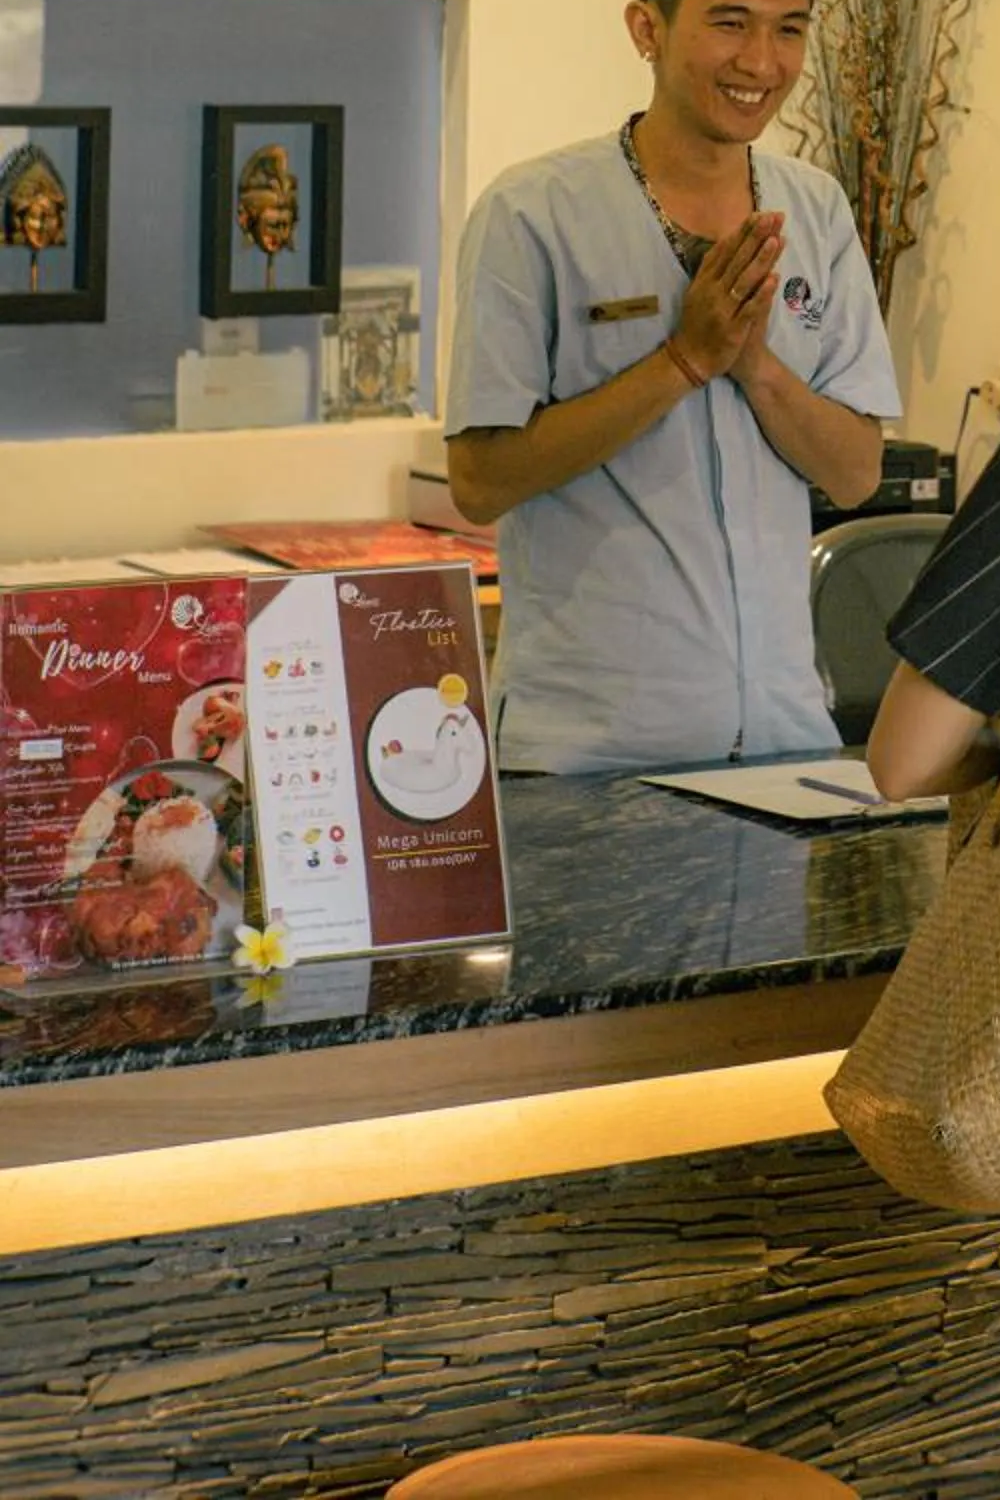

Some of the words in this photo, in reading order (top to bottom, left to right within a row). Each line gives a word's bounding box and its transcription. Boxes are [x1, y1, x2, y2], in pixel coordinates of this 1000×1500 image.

[428, 631, 459, 647] List
[40, 638, 145, 681] Dinner
[137, 671, 173, 684] Menu
[377, 835, 419, 851] Mega
[423, 828, 483, 845] Unicorn
